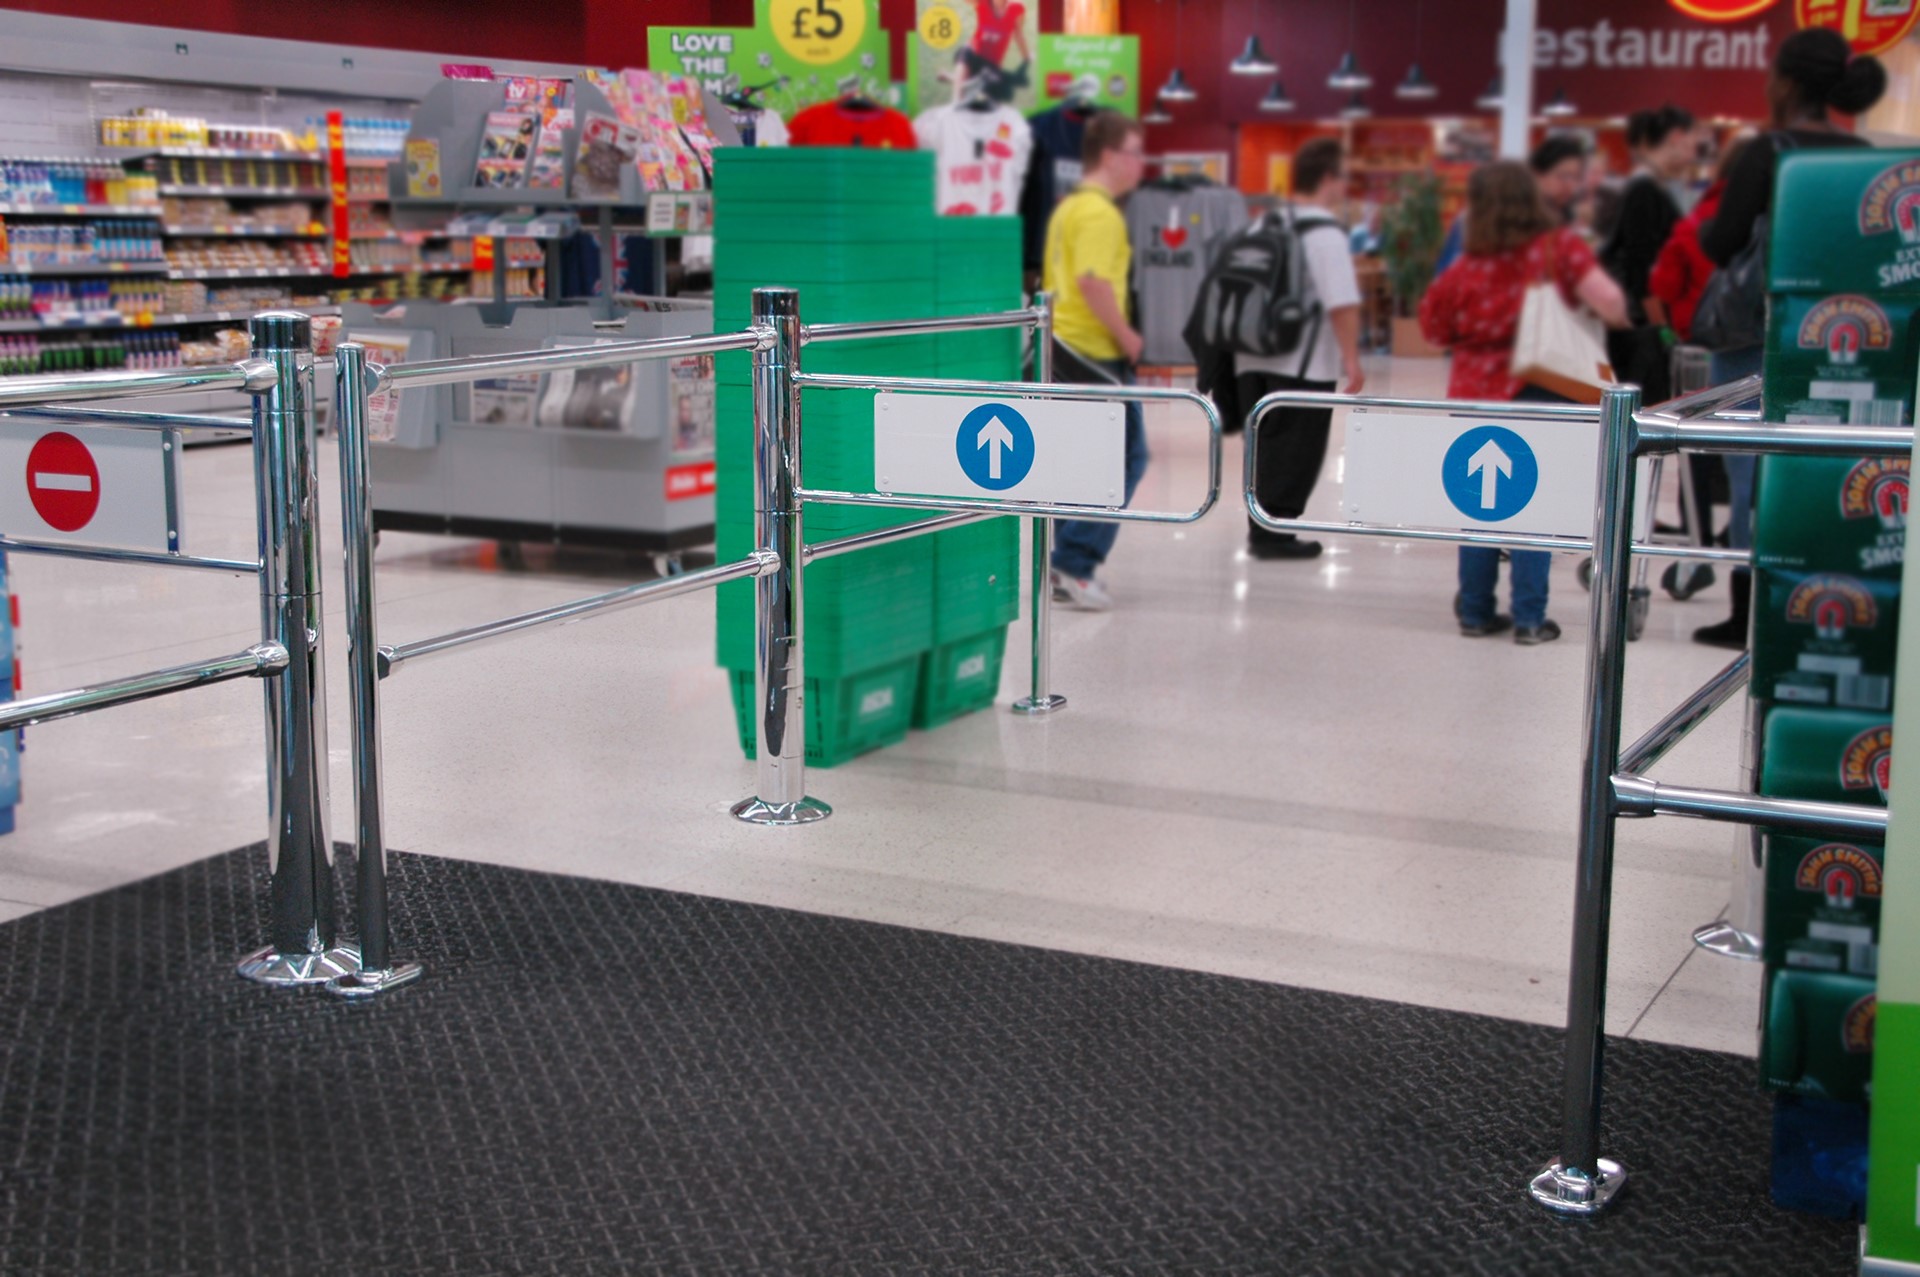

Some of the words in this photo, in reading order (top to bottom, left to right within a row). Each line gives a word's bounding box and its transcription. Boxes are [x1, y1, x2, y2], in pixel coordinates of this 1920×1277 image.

[791, 0, 844, 40] £5
[929, 17, 952, 39] £8
[671, 33, 733, 54] LOVE
[1497, 18, 1769, 69] estaurant
[681, 56, 726, 75] THE
